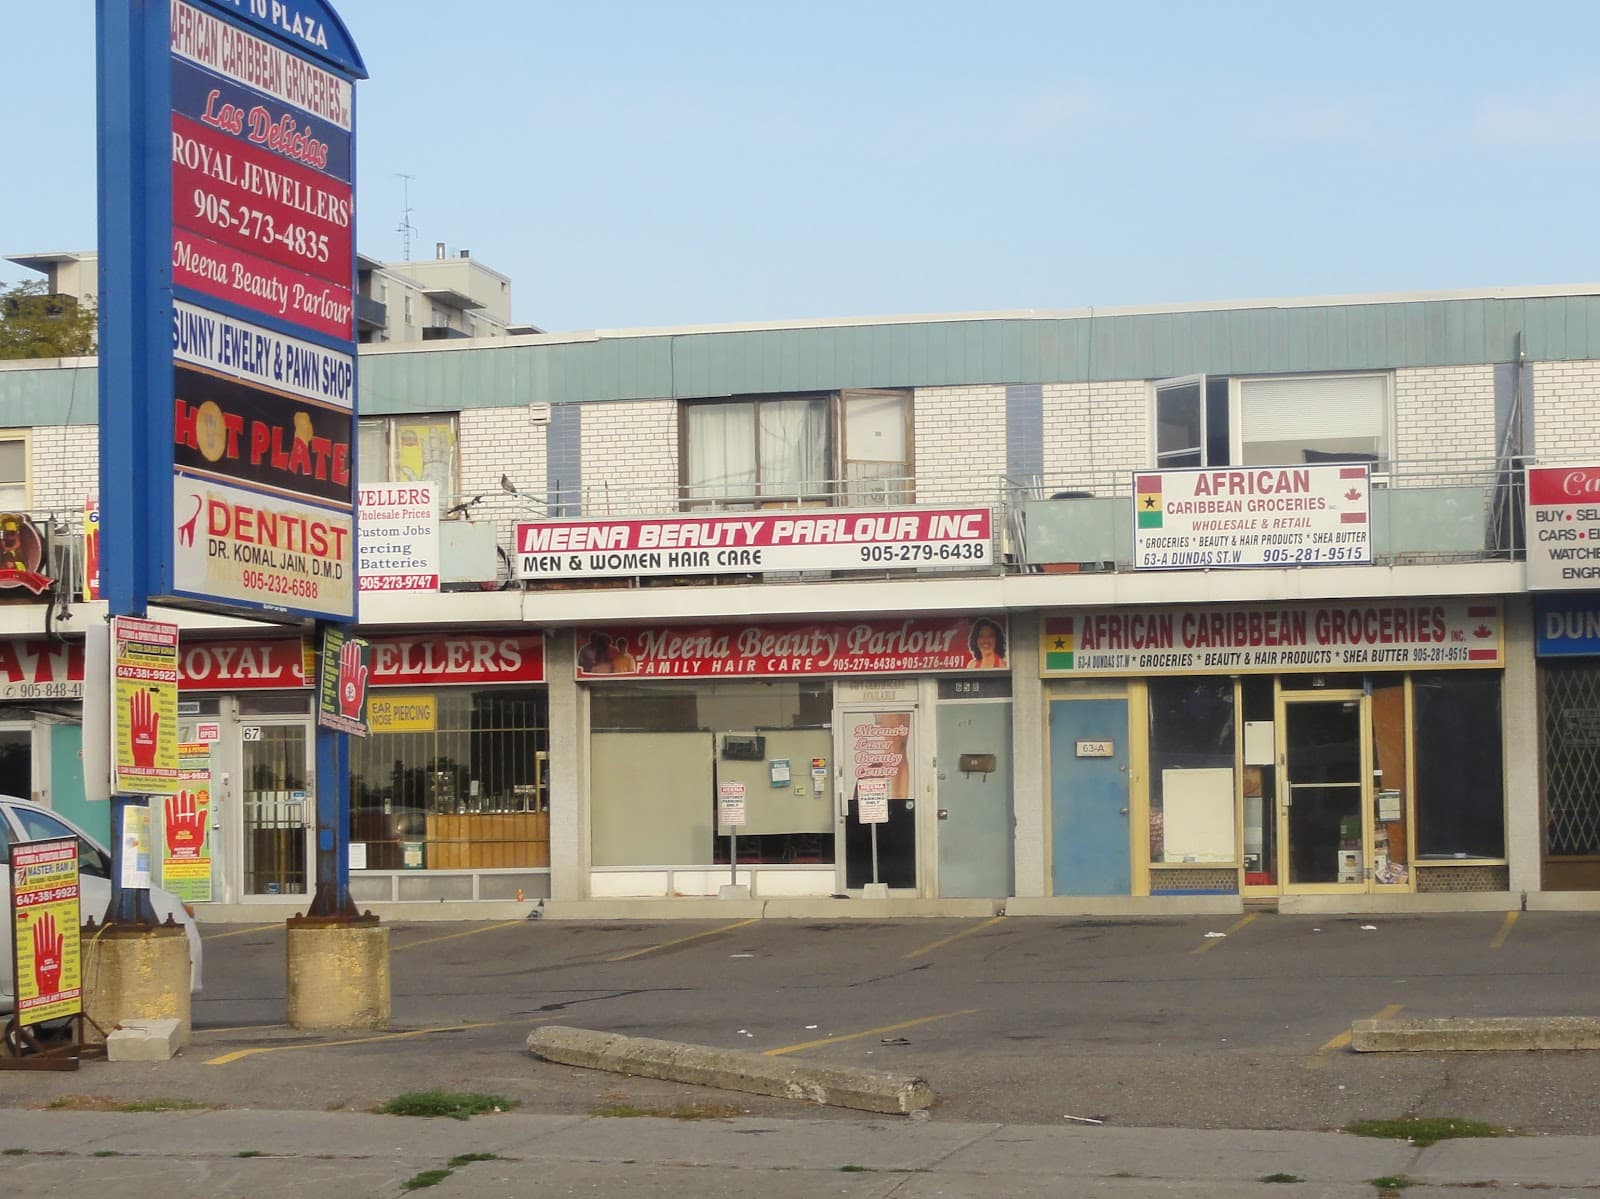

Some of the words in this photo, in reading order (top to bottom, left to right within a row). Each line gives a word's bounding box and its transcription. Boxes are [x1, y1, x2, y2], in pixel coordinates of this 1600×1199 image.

[272, 1, 328, 50] PLAZA
[171, 3, 219, 62] AFRICAN
[222, 25, 282, 90] CARIBBEAN
[285, 53, 341, 124] GROCERIES
[202, 89, 243, 135] Las
[248, 105, 329, 169] Delicias
[172, 131, 238, 185] ROYAL
[241, 161, 348, 227] JEWELLERS
[194, 189, 329, 263] 905-273-4835
[173, 241, 228, 284] Meena
[232, 262, 289, 314] Beauty
[293, 283, 351, 325] Parlour
[173, 307, 215, 361] SUNNY
[218, 322, 271, 377] JEWELRY
[274, 341, 283, 382] &
[286, 344, 320, 392] PAWN
[323, 355, 352, 401] SHOP
[174, 399, 245, 462] HOT
[251, 419, 350, 487] PLATE
[1193, 470, 1310, 497] AFRICAN
[402, 508, 431, 520] Prices
[1166, 500, 1243, 515] CARIBBEAN
[1247, 497, 1326, 512] GROCERIES
[1536, 510, 1565, 522] BUY
[207, 499, 348, 561] DENTIST
[402, 525, 431, 536] Jobs
[524, 525, 631, 552] MEENA
[637, 521, 765, 548] BEAUTY
[771, 516, 920, 545] PARLOUR
[928, 514, 983, 539] INC
[1192, 519, 1258, 532] WHOLESALE
[1261, 519, 1269, 530] &
[1272, 517, 1312, 530] RETAIL
[1538, 528, 1577, 542] CARS
[1145, 536, 1190, 549] GROCERIES
[1199, 535, 1229, 547] BEAUTY
[1231, 535, 1237, 546] &
[1239, 534, 1259, 547] HAIR
[1261, 533, 1304, 545] PRODUCTS
[1312, 532, 1333, 544] SHEA
[1335, 531, 1367, 544] BUTTER
[208, 539, 230, 560] DR.
[233, 543, 277, 570] KOMAL
[360, 558, 428, 570] Batteries
[523, 556, 562, 572] MEN
[569, 555, 583, 571] &
[590, 553, 661, 570] WOMEN
[669, 551, 710, 568] HAIR
[717, 549, 762, 566] CARE
[860, 543, 984, 562] 905-279-6438
[1143, 552, 1168, 566] 63-A
[1171, 551, 1213, 566] DUNDAS
[1263, 546, 1363, 562] 905-281-9515
[243, 570, 319, 599] 905-232-6588
[360, 575, 432, 589] 905-273-9747
[1080, 613, 1174, 651] AFRICAN
[1182, 609, 1307, 649] CARIBBEAN
[1315, 606, 1447, 646] GROCERIES
[635, 629, 730, 661] Meena
[738, 625, 839, 667] Beauty
[847, 619, 958, 656] Parlour
[635, 660, 703, 675] FAMILY
[711, 659, 756, 673] HAIR
[767, 658, 813, 671] CARE
[1139, 653, 1193, 668] GROCERIES
[1204, 652, 1243, 666] BEAUTY
[1244, 652, 1251, 665] &
[1254, 651, 1278, 665] HAIR
[1280, 650, 1332, 665] PRODUCTS
[1343, 649, 1368, 664] SHEA
[1371, 648, 1409, 663] BUTTER
[1413, 647, 1468, 662] 905-281-9515
[117, 667, 176, 681] 647-381-9922
[372, 702, 391, 714] EAR
[393, 704, 431, 721] PIERCING
[372, 714, 392, 726] NOSE
[243, 727, 259, 741] 67
[16, 886, 78, 906] 647-381-9922
